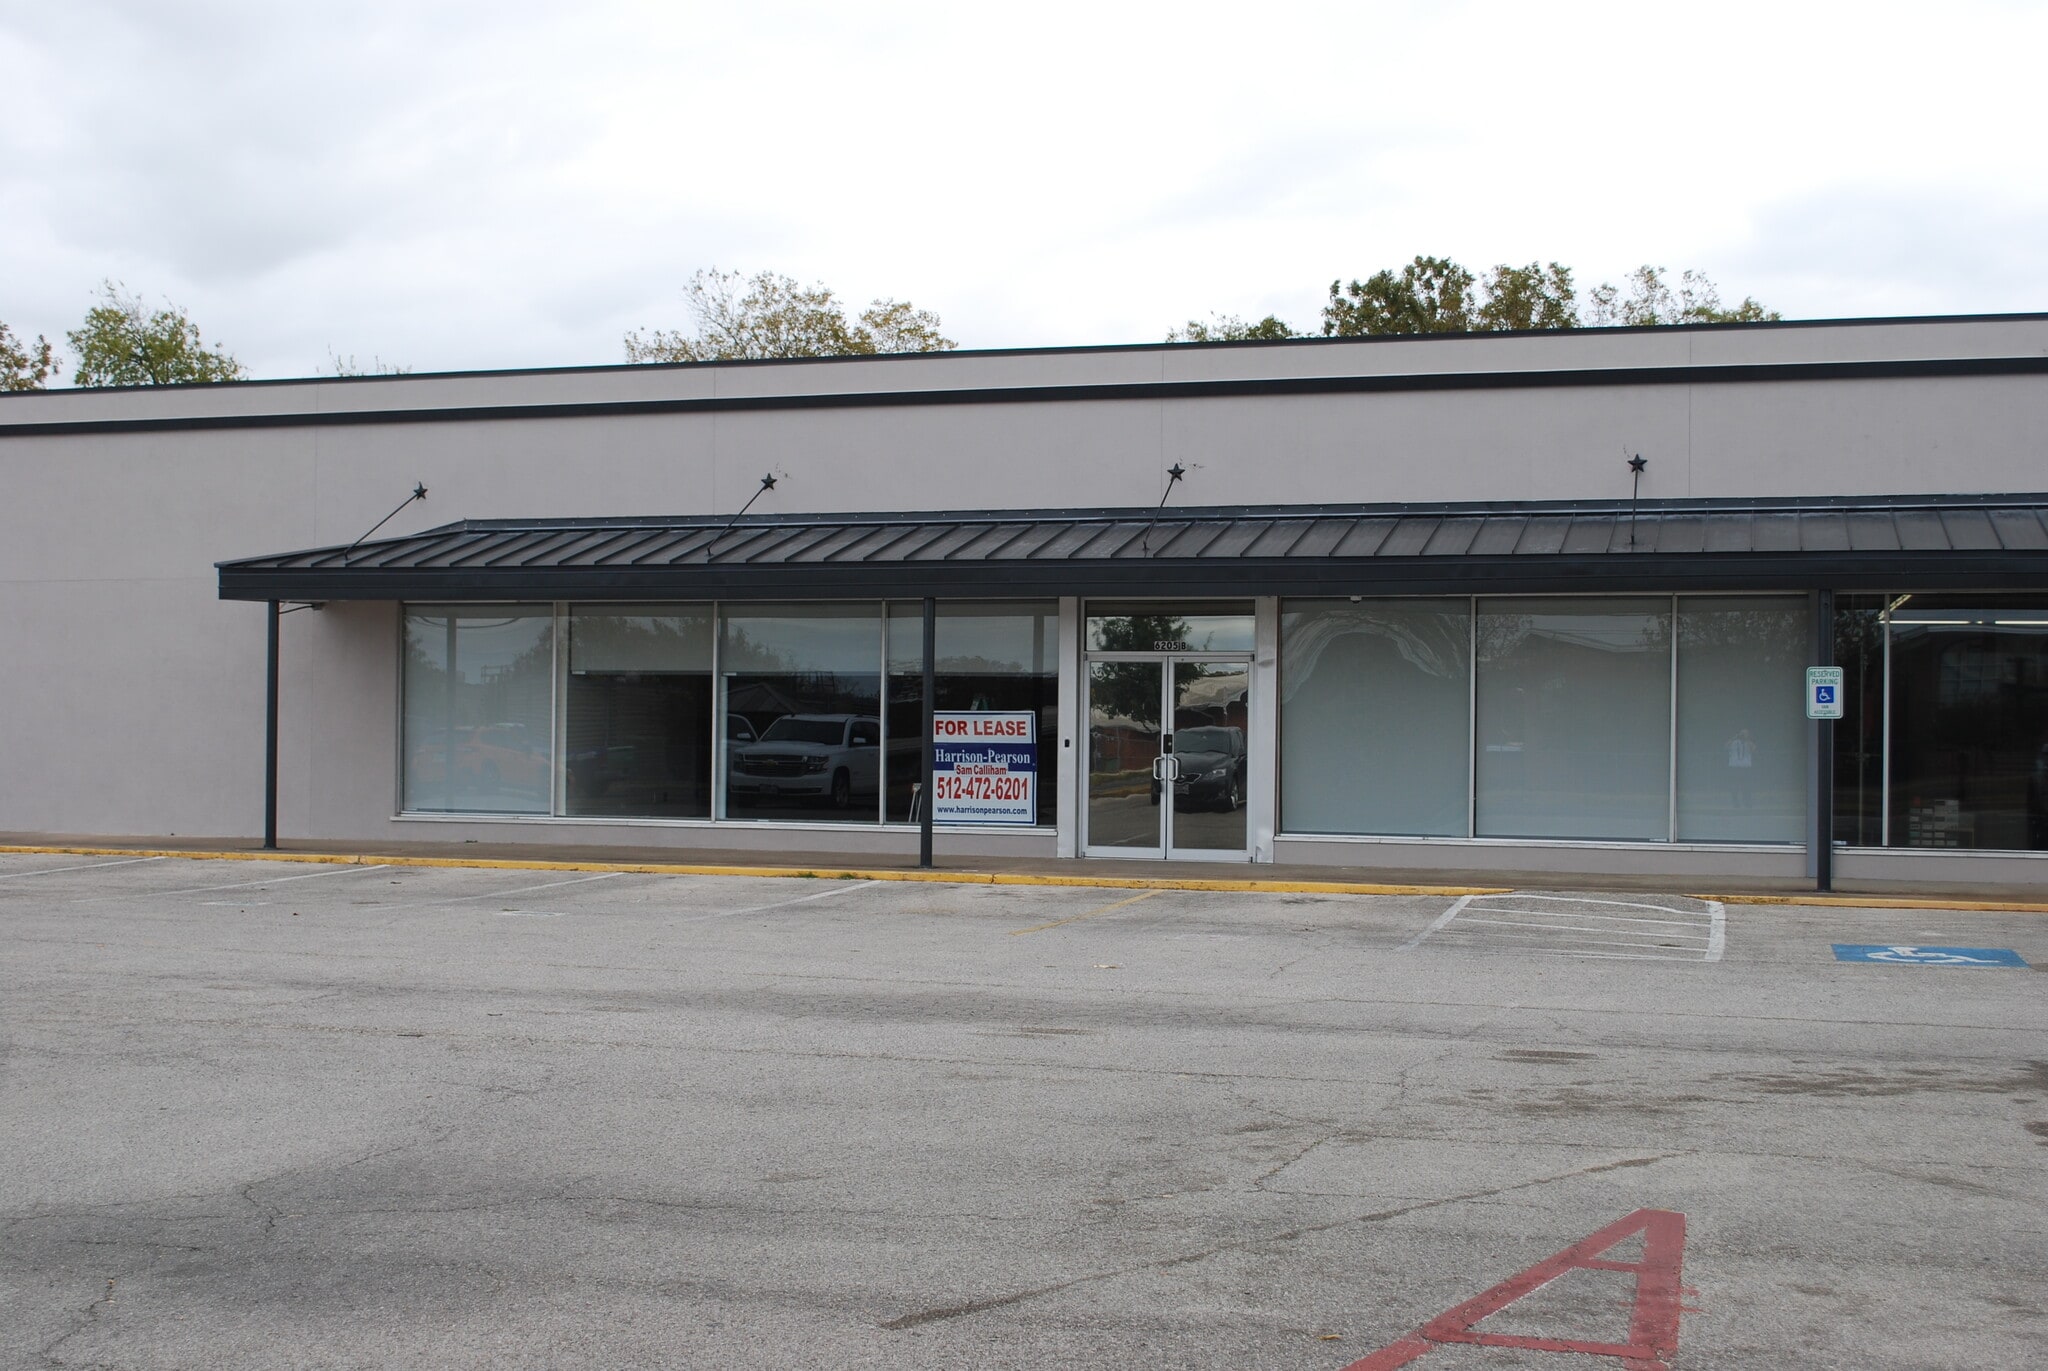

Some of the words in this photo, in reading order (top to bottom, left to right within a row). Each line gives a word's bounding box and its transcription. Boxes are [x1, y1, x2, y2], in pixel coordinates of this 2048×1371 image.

[1155, 641, 1178, 650] 6205
[935, 720, 969, 736] FOR
[973, 720, 1027, 736] LEASE
[935, 748, 1031, 764] Harrison-Pearson
[956, 764, 973, 775] Sam
[973, 764, 1007, 775] Calliham
[937, 777, 1028, 800] 512-472-6201
[937, 806, 1028, 816] www.harrisonpearson.com
